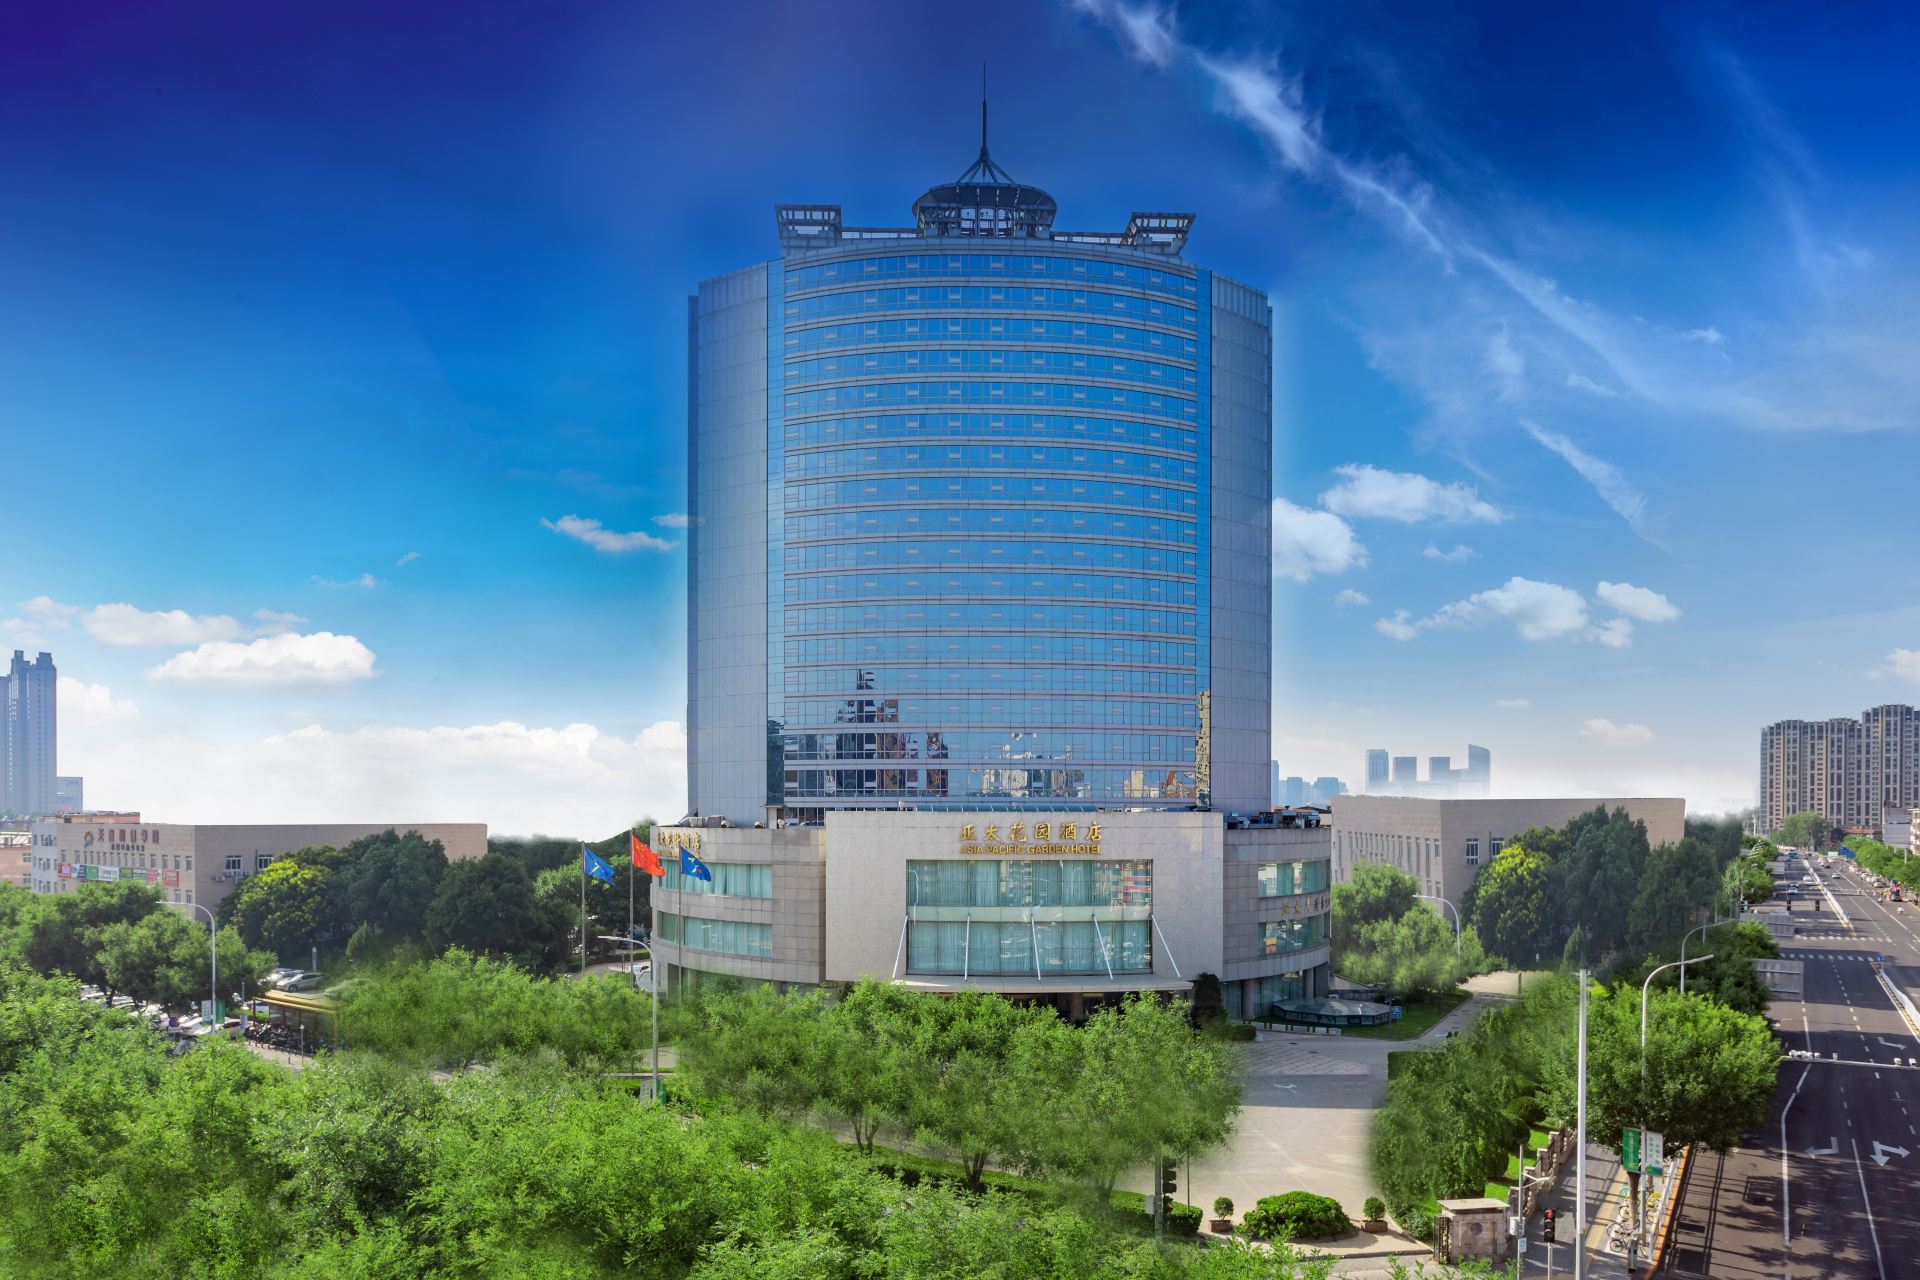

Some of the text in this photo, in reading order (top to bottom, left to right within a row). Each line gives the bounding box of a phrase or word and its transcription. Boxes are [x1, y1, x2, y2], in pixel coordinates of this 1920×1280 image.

[961, 822, 1103, 842] 亚太花园酒店
[960, 843, 1102, 854] ASIA PACIFIC GARDEN HOTEL
